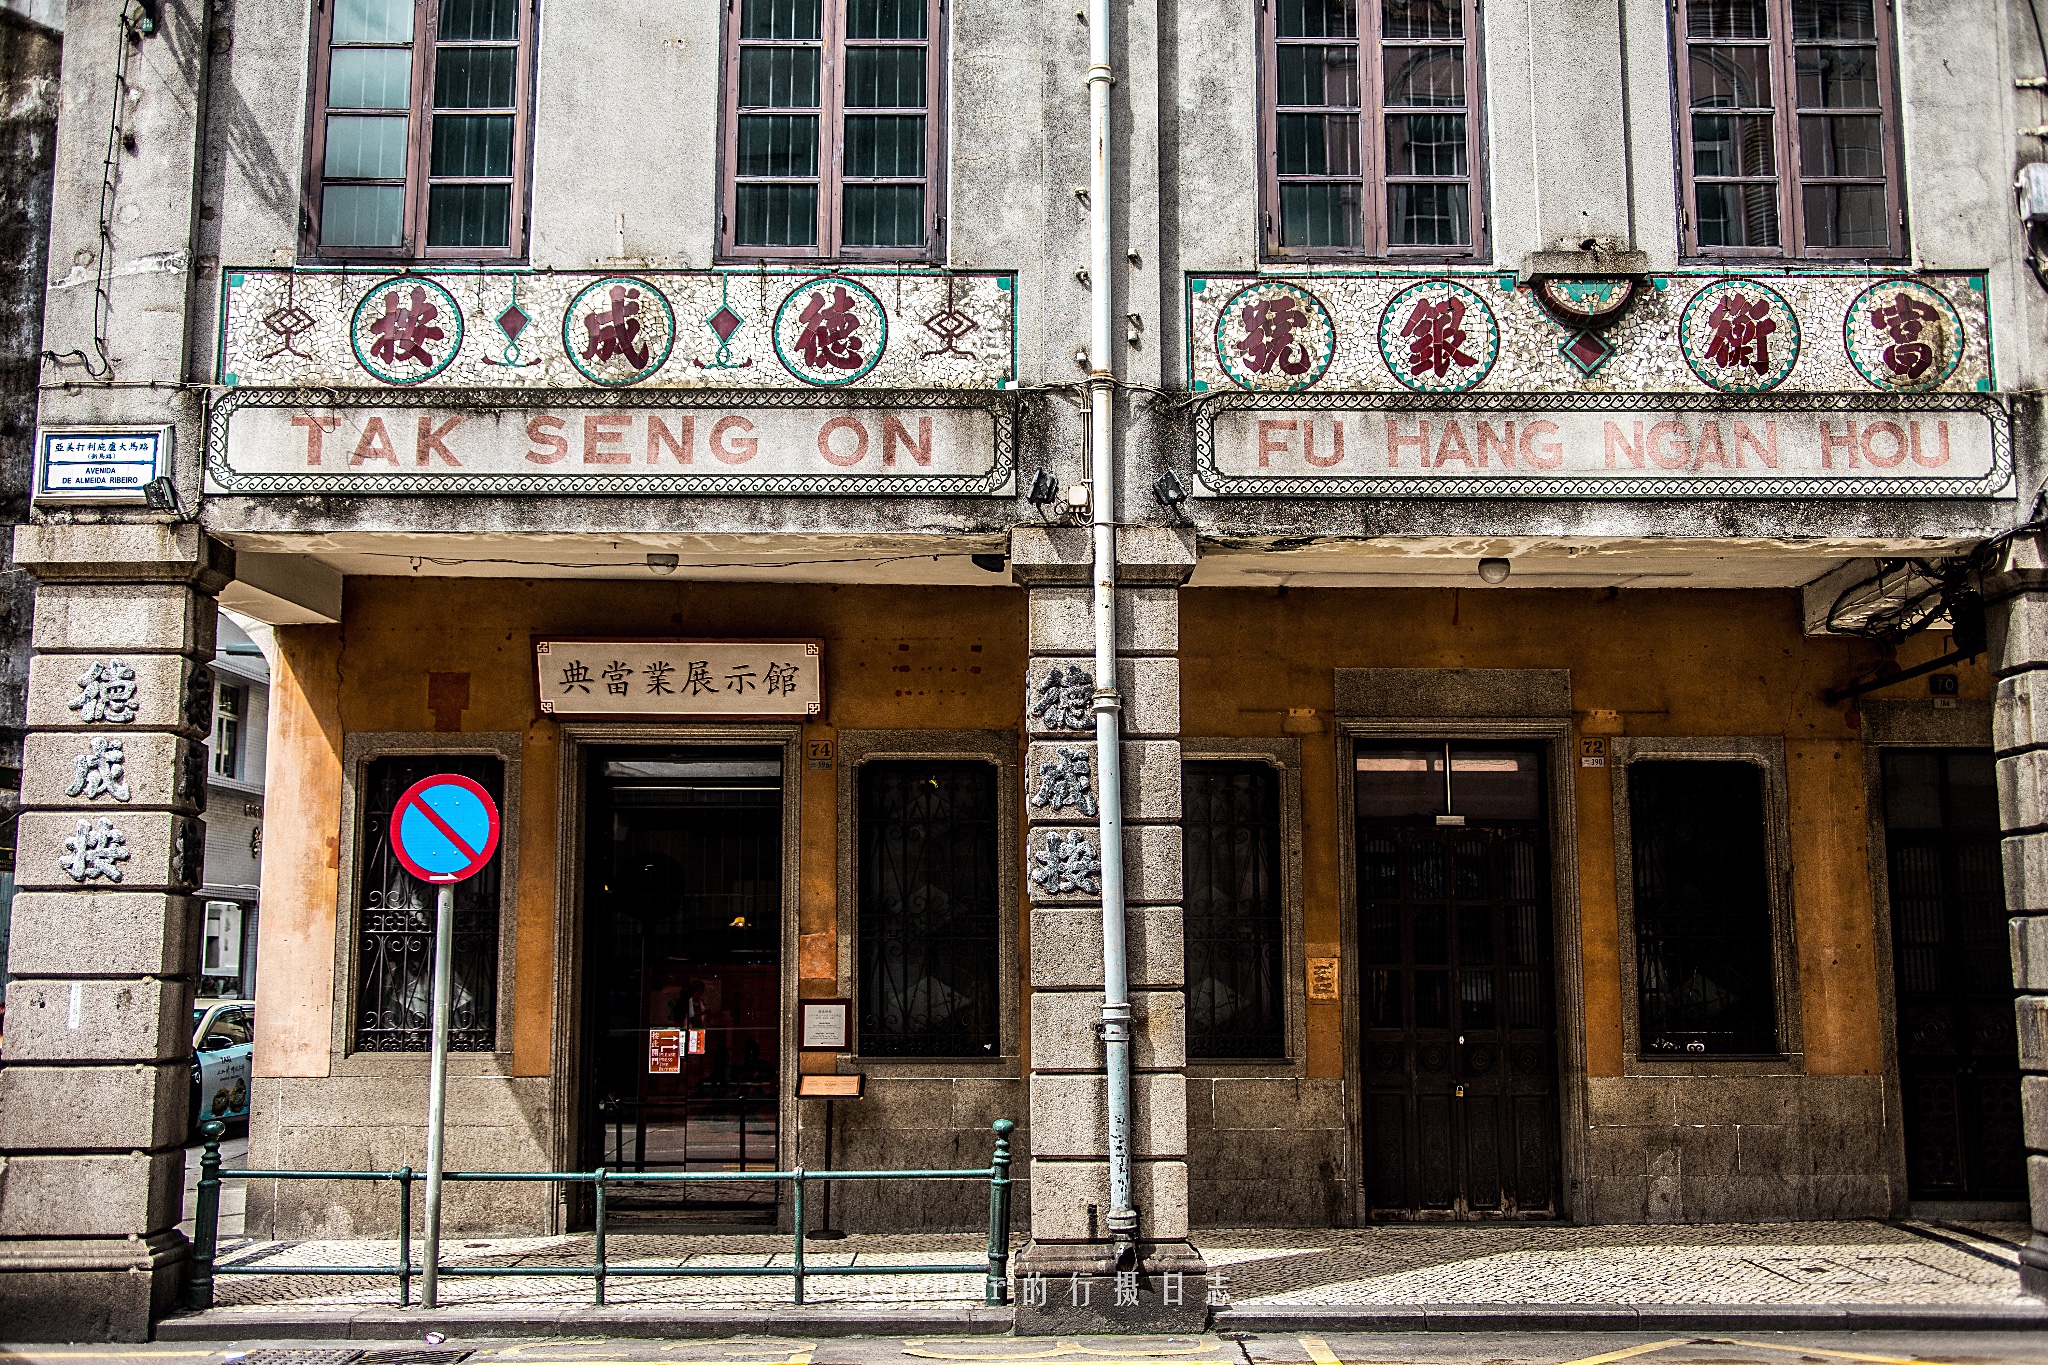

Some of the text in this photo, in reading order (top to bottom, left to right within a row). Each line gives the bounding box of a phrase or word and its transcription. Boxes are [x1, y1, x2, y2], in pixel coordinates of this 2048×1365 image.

[291, 415, 933, 467] TAK SENG ON
[1257, 419, 1950, 470] FU HANG NGAN HOU
[85, 467, 116, 475] AVENIDA
[75, 476, 106, 484] ALMEIDA
[109, 476, 138, 484] RIBEIRO
[559, 659, 800, 697] 典當業展示館
[1936, 678, 1954, 691] 70
[810, 742, 831, 757] 74
[1582, 740, 1604, 754] 72
